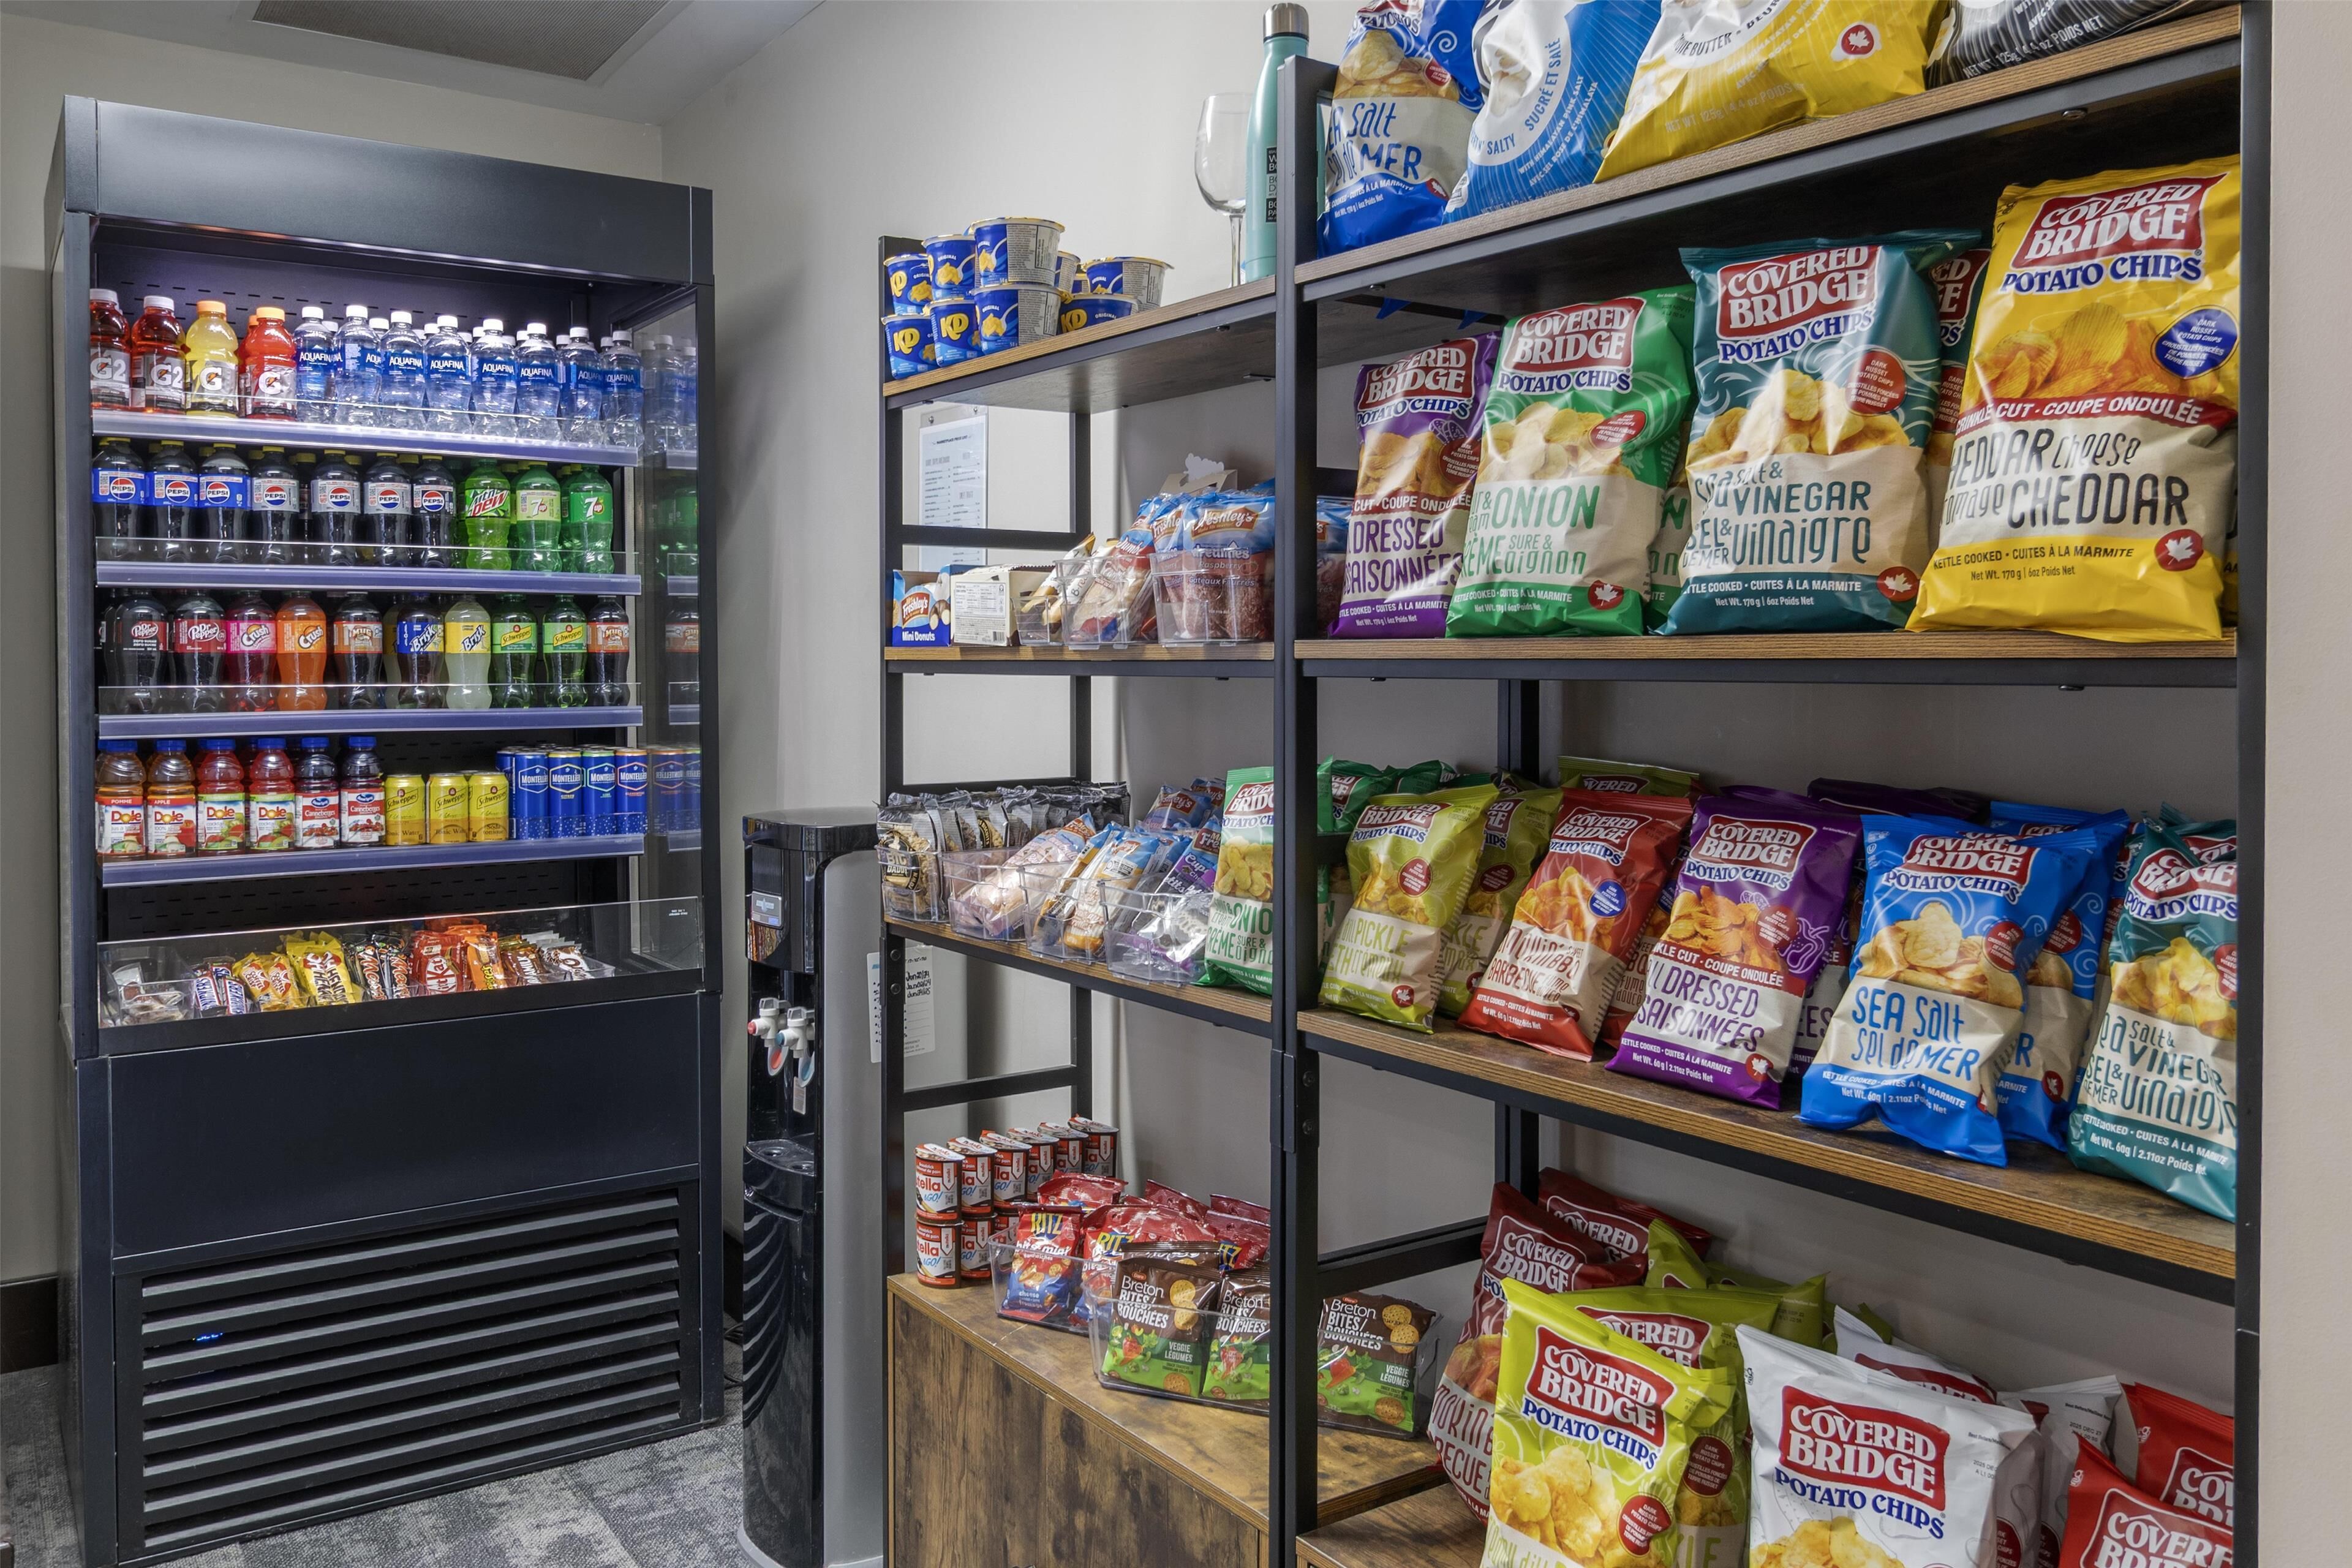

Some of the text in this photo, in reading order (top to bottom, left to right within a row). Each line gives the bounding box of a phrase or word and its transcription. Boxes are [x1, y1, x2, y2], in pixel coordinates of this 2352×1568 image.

[1525, 37, 1561, 131] SUCRÉ ET SALÉ
[1487, 133, 1515, 155] SALTY
[2041, 184, 2201, 229] COVERED
[2025, 203, 2191, 261] BRIDGE
[1728, 246, 1869, 297] COVERED
[2002, 255, 2203, 293] POTATO CHIPS
[1728, 268, 1868, 329] BRIDGE
[941, 312, 969, 340] KD
[1061, 309, 1088, 333] KD
[1521, 307, 1634, 337] COVERED
[894, 328, 921, 355] KD
[1513, 331, 1627, 364] BRIDGE
[1721, 311, 1872, 361] POTATO CHIPS
[91, 356, 127, 382] G2
[390, 355, 423, 369] AQUAFINA
[431, 360, 465, 372] AQUAFINA
[482, 363, 514, 375] AQUAFINA
[521, 368, 553, 378] AQUAFINA
[1371, 347, 1467, 382] COVERED
[151, 364, 183, 388] G2
[200, 367, 222, 390] G
[258, 371, 281, 394] G
[1365, 369, 1466, 405] BRIDGE
[1498, 370, 1632, 393] POTATO CHIPS
[1357, 398, 1471, 429] POTATO CHIPS
[1996, 404, 2031, 419] CUT
[2042, 398, 2101, 415] COUPE
[2109, 397, 2203, 426] ONDULÉE
[1950, 428, 2054, 489] HEDDAR
[1354, 491, 1471, 513] CUT COUPE ONDULÉE
[1491, 484, 1600, 530] ONION
[1733, 481, 1871, 516] VINEGAR
[2007, 472, 2190, 529] CHEDDAR
[1353, 516, 1444, 554] DRESSED
[1509, 535, 1552, 550] SURE &
[1199, 561, 1242, 570] Raspberry
[1934, 544, 2135, 570] KETTLE COOKED CUITES À LA MARMITE
[133, 627, 157, 636] Pepper
[189, 628, 218, 641] Pepper
[199, 623, 211, 631] Dr
[241, 624, 269, 647] Crush
[298, 625, 325, 649] Crush
[411, 624, 437, 652] Brisk
[462, 625, 486, 651] Brisk
[902, 631, 935, 641] Mini Donuts
[206, 807, 235, 818] Dole
[259, 807, 287, 819] Dole
[387, 795, 418, 808] Schweppes
[111, 811, 141, 824] Dole
[154, 811, 184, 823] Dole
[1363, 807, 1431, 823] BRIDGE
[1570, 813, 1638, 830] COVERED
[1352, 825, 1427, 843] POTATO CHIPS
[1555, 823, 1628, 843] BRIDGE
[1709, 821, 1800, 846] COVERED
[1699, 837, 1795, 867] BRIDGE
[1686, 862, 1792, 889] POTATO CHIPS
[1885, 871, 2020, 903] POTATO CHIPS
[2125, 891, 2185, 919] POTATO
[1237, 935, 1265, 949] SURE &
[1355, 917, 1413, 957] PICKLE
[1677, 949, 1698, 963] CUT
[1705, 957, 1740, 975] COUPE
[1742, 967, 1783, 987] ONDULÉE
[1661, 966, 1759, 1018] DRESSED
[1852, 986, 1905, 1033] SEA
[1915, 1044, 1980, 1081] MER
[2086, 1054, 2122, 1088] SEL &
[1822, 1070, 1849, 1083] KETTLE
[1849, 1076, 1877, 1086] COOKED
[1909, 1077, 1915, 1087] À
[1917, 1080, 1926, 1091] LA
[1928, 1087, 1967, 1109] MARMITE
[2092, 1084, 2118, 1106] MER
[2090, 1133, 2100, 1145] Net
[2100, 1136, 2114, 1150] Wt.
[2138, 1150, 2165, 1164] 2.11oz
[2167, 1158, 2193, 1172] Poids
[2136, 1130, 2169, 1145] CUITES
[2171, 1138, 2179, 1149] À
[2181, 1143, 2195, 1153] LA
[1031, 1212, 1064, 1235] RITZ
[1503, 1232, 1575, 1270] COVERED
[1493, 1251, 1569, 1292] BRIDGE
[1121, 1276, 1164, 1298] Breton
[1224, 1290, 1263, 1309] Breton
[1118, 1305, 1169, 1328] BOUCHÉES
[1331, 1298, 1376, 1318] Breton
[1215, 1317, 1266, 1333] BOUCHÉES
[1328, 1313, 1367, 1331] BITES/
[1164, 1350, 1193, 1363] LÉGUMES
[1169, 1341, 1191, 1353] VEGGIE
[1380, 1372, 1410, 1388] LÉGUMES
[1385, 1364, 1409, 1378] VEGGIE
[1544, 1346, 1658, 1407] COVERED
[1538, 1365, 1657, 1436] BRIDGE
[1523, 1398, 1599, 1441] POTATO
[1603, 1428, 1658, 1470] CHIPS
[1790, 1405, 1936, 1462] COVERED
[1787, 1430, 1936, 1499] BRIDGE
[1775, 1466, 1944, 1540] POTATO CHIPS
